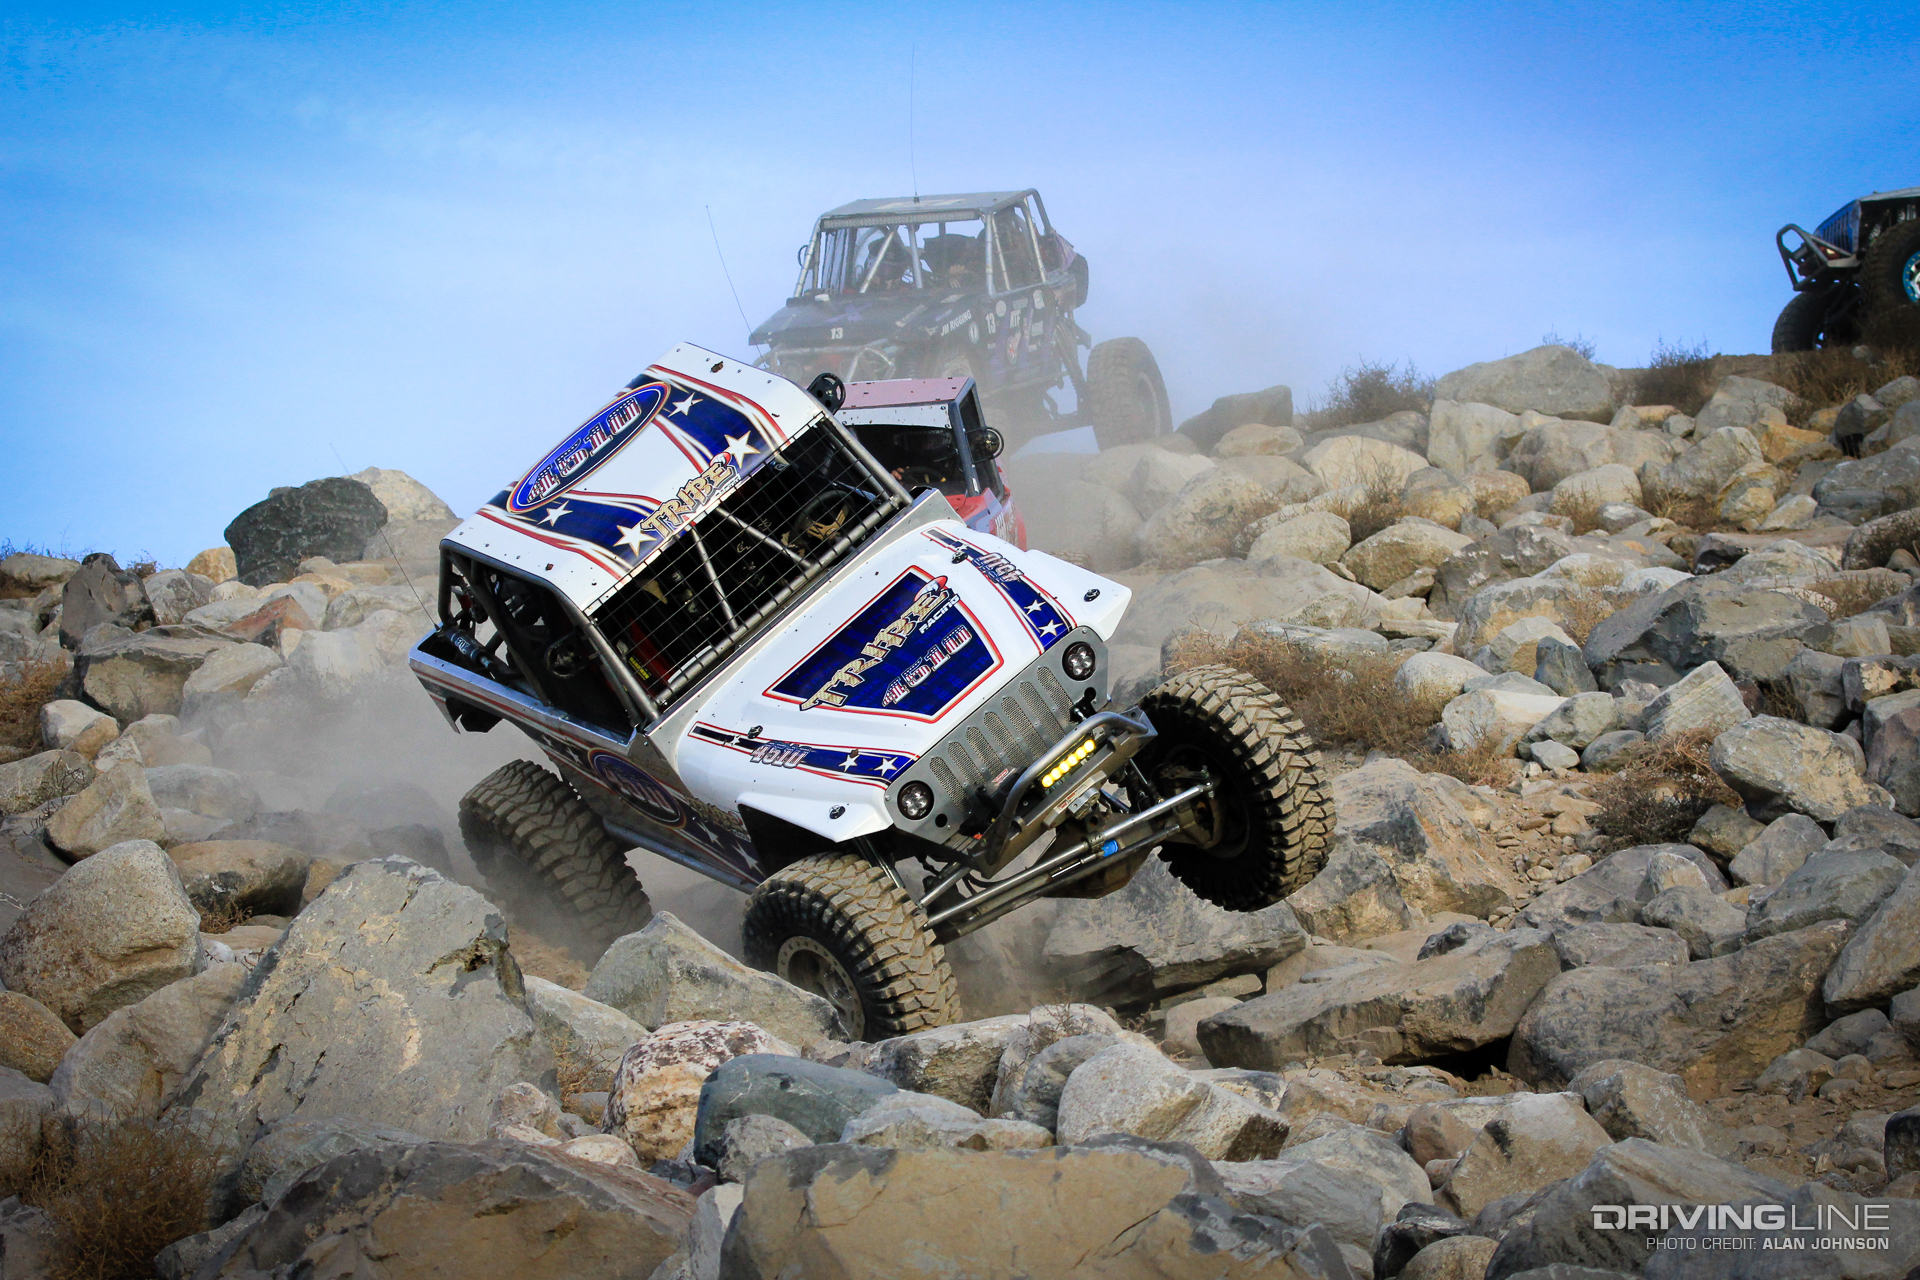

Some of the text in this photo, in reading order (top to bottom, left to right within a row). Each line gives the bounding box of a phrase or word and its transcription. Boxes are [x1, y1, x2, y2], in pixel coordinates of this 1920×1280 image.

[830, 327, 844, 340] 13
[986, 312, 996, 334] 13
[527, 396, 642, 503] 4510
[640, 462, 737, 539] TRIBE
[799, 589, 953, 711] TRIBE
[881, 624, 973, 707] 4510
[750, 740, 812, 769] 4510
